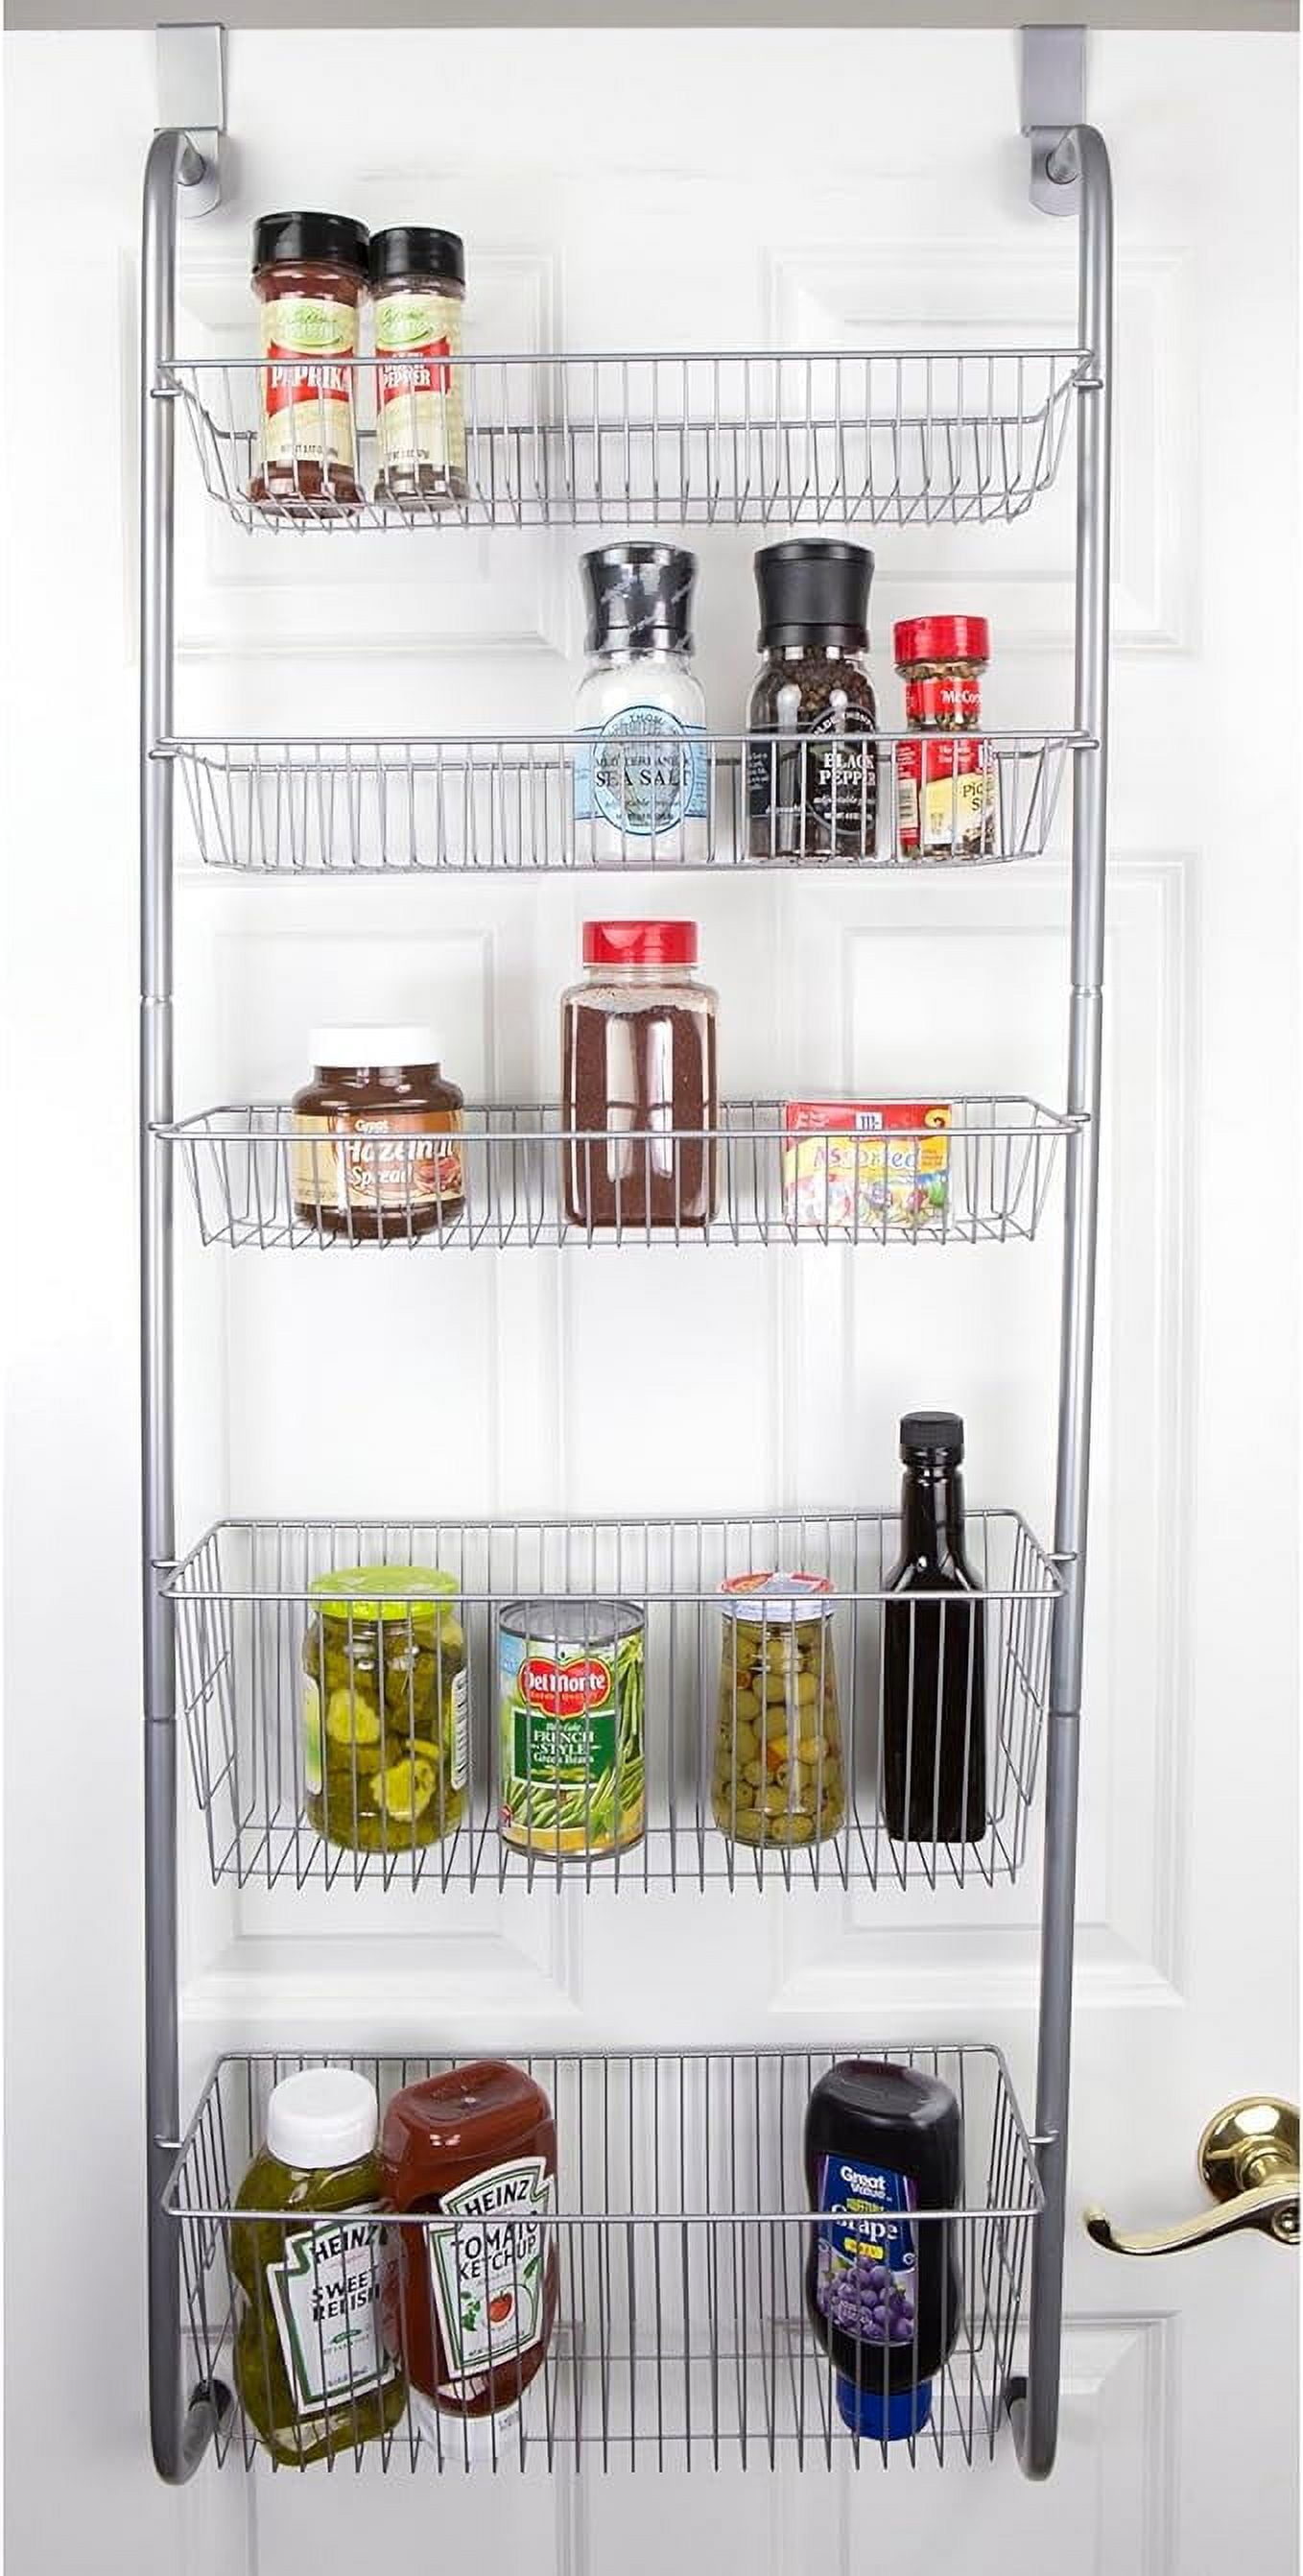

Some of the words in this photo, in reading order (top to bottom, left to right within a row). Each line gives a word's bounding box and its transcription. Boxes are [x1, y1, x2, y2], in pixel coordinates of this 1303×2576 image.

[596, 769, 633, 788] SEA
[640, 768, 690, 787] SALT
[824, 752, 874, 769] BLACK
[841, 2165, 886, 2190] Great
[463, 2180, 530, 2216] HEINZ
[309, 2224, 381, 2264] HEINZ
[450, 2210, 538, 2260] TOMATO
[459, 2234, 536, 2280] KETCHUP
